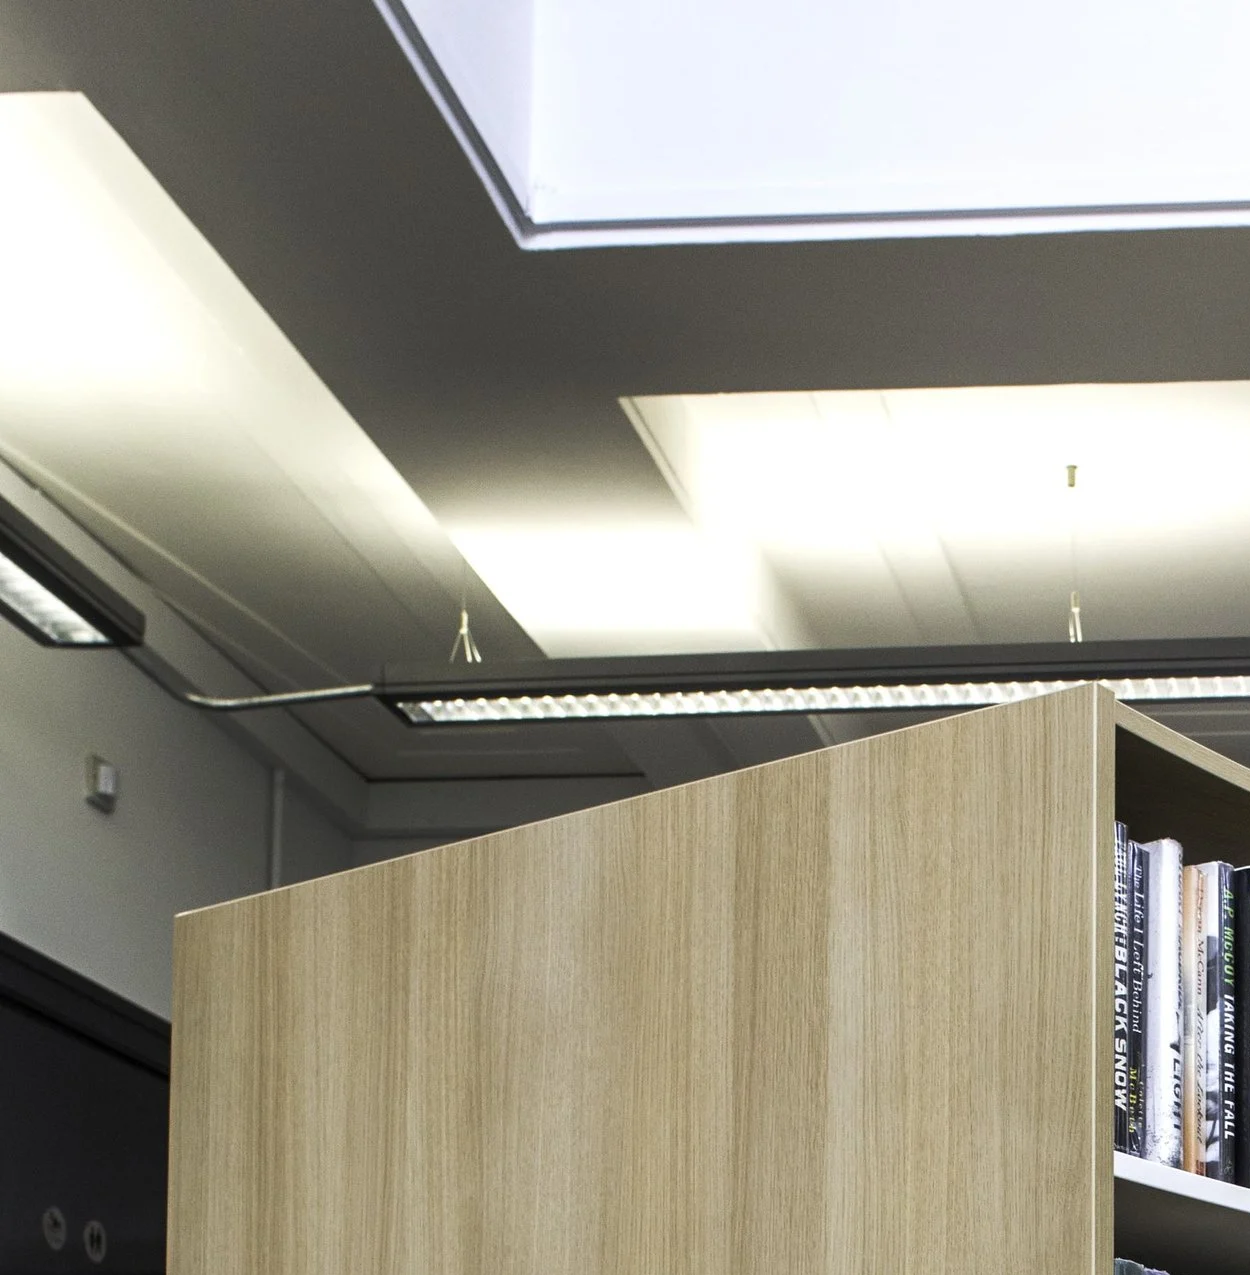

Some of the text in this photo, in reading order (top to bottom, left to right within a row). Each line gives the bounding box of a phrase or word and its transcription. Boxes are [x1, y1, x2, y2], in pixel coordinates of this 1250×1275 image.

[1134, 866, 1143, 888] The
[1132, 892, 1145, 922] Life
[1132, 940, 1144, 975] Left
[1114, 947, 1127, 1032] BLACK
[1132, 980, 1144, 1032] Behind
[1115, 1038, 1126, 1111] SNOW
